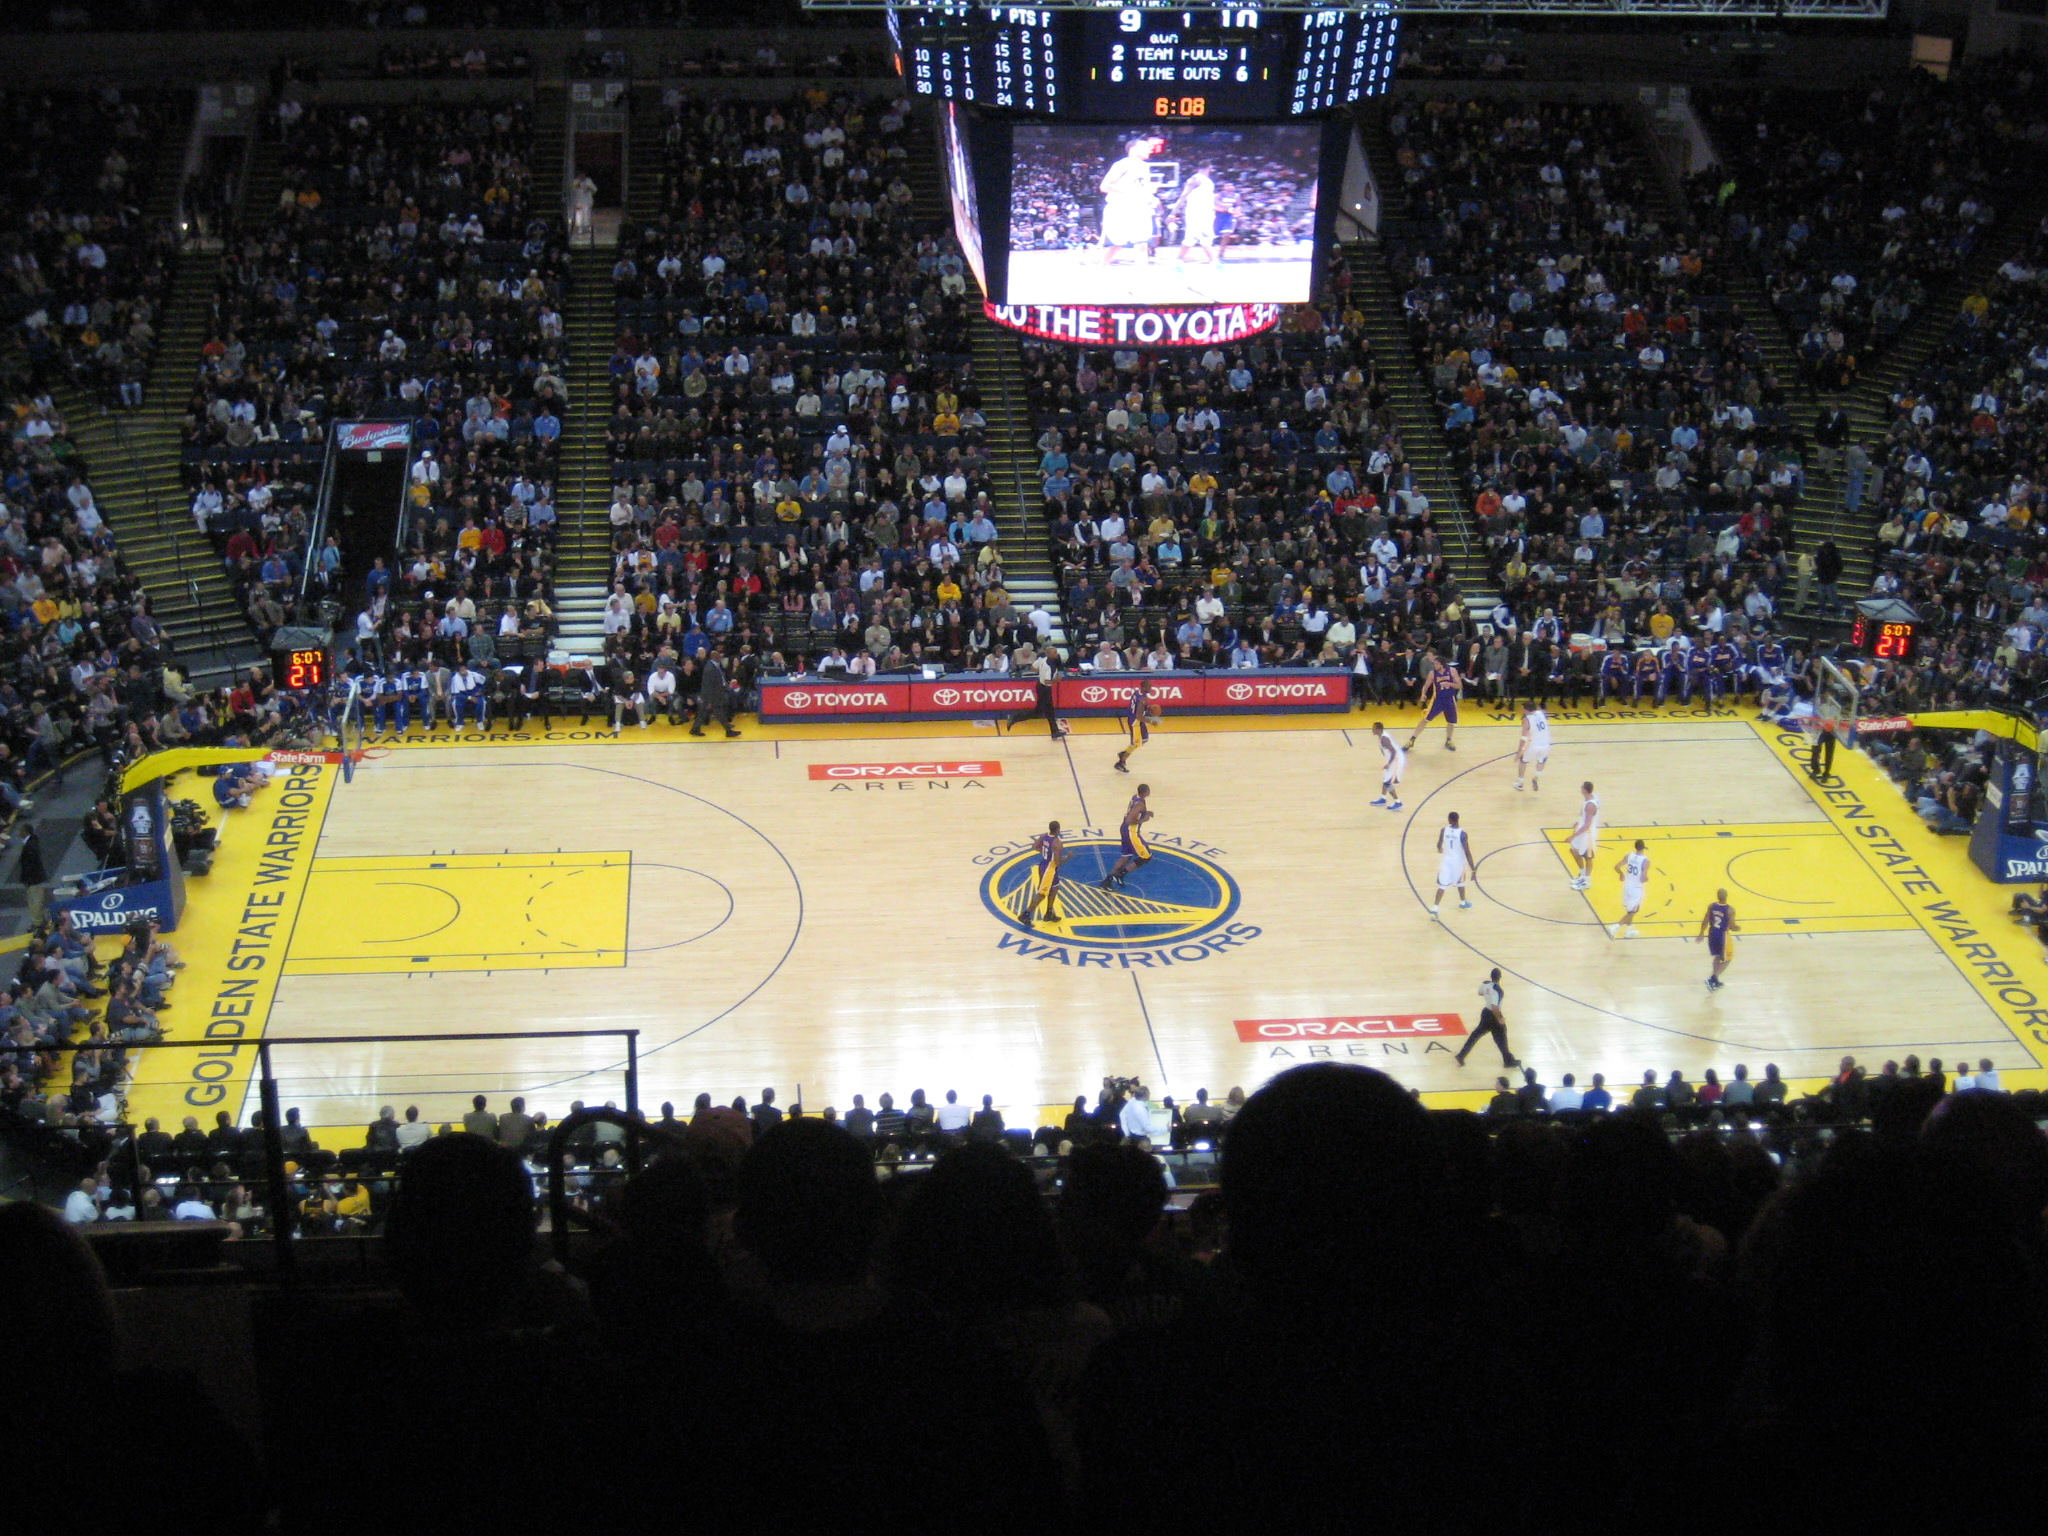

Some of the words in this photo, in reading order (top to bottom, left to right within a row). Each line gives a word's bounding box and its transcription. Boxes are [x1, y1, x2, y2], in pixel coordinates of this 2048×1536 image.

[1009, 8, 1036, 27] PTS
[1042, 12, 1050, 28] F
[1119, 9, 1142, 32] 9
[1182, 12, 1191, 28] 1
[1304, 15, 1312, 31] P
[1316, 12, 1337, 28] PTS
[1362, 24, 1369, 36] 2
[1376, 21, 1383, 34] 2
[1391, 18, 1397, 31] 0
[1021, 31, 1030, 44] 2
[1043, 33, 1052, 46] 0
[1321, 32, 1328, 44] 0
[1336, 29, 1343, 42] 0
[1356, 40, 1367, 53] 15
[1374, 37, 1381, 49] 2
[1388, 34, 1395, 46] 0
[915, 49, 930, 62] 10
[942, 52, 950, 65] 2
[964, 55, 971, 68] 1
[995, 43, 1009, 57] 15
[1022, 47, 1031, 60] 2
[1044, 50, 1053, 63] 0
[1112, 45, 1124, 61] 2
[1136, 48, 1173, 60] TEAM
[1319, 48, 1325, 60] 4
[1333, 45, 1340, 58] 0
[1353, 57, 1364, 70] 16
[1371, 53, 1378, 65] 0
[1386, 50, 1392, 62] 0
[916, 65, 931, 78] 15
[943, 69, 951, 81] 0
[965, 72, 971, 84] 1
[996, 60, 1011, 73] 16
[1023, 64, 1032, 76] 0
[1045, 67, 1054, 79] 0
[1111, 66, 1123, 82] 6
[1138, 67, 1175, 80] TIME
[1183, 67, 1221, 80] OUTS
[1236, 66, 1248, 82] 6
[1297, 68, 1308, 82] 10
[1316, 65, 1324, 77] 2
[1331, 62, 1337, 74] 1
[1351, 72, 1362, 86] 17
[1369, 69, 1375, 81] 2
[1383, 66, 1389, 78] 0
[917, 81, 932, 94] 30
[944, 85, 953, 97] 3
[965, 88, 974, 100] 0
[997, 77, 1011, 89] 17
[1025, 81, 1033, 93] 2
[1046, 84, 1055, 96] 0
[1295, 84, 1306, 98] 15
[1314, 81, 1321, 93] 0
[1329, 78, 1334, 90] 1
[1348, 88, 1359, 101] 24
[1367, 85, 1373, 97] 4
[1381, 82, 1386, 94] 1
[997, 92, 1012, 106] 24
[1025, 97, 1034, 109] 4
[1049, 100, 1055, 113] 1
[1155, 97, 1205, 116] 6:08
[1291, 101, 1304, 114] 30
[1312, 97, 1318, 110] 3
[1326, 93, 1333, 106] 0
[1034, 304, 1100, 340] THE
[1112, 307, 1248, 342] TOYOTA
[342, 423, 410, 449] Budweiser
[1884, 624, 1911, 636] 6:07
[1877, 635, 1905, 656] 21
[292, 651, 322, 664] 6:07
[290, 665, 319, 687] 21
[814, 693, 887, 706] TOYOTA
[963, 689, 1036, 702] TOYOTA
[1256, 683, 1326, 697] TOYOTA
[1487, 709, 1738, 721] WRRIORS.COM
[1536, 721, 1545, 731] 10
[352, 732, 619, 744] WARRIORS.COM
[827, 764, 983, 777] ORACLE
[830, 780, 985, 791] ARENA
[253, 764, 322, 887] WARRIORS
[1149, 832, 1227, 859] TATE
[1627, 864, 1638, 875] 30
[1856, 825, 1942, 895] STATE
[228, 891, 285, 971] STATE
[1714, 916, 1722, 929] 2
[997, 922, 1262, 969] WARRIORS
[1258, 1018, 1443, 1037] ORACLE
[184, 978, 259, 1107] GOLDEN
[1269, 1041, 1452, 1058] ARENA
